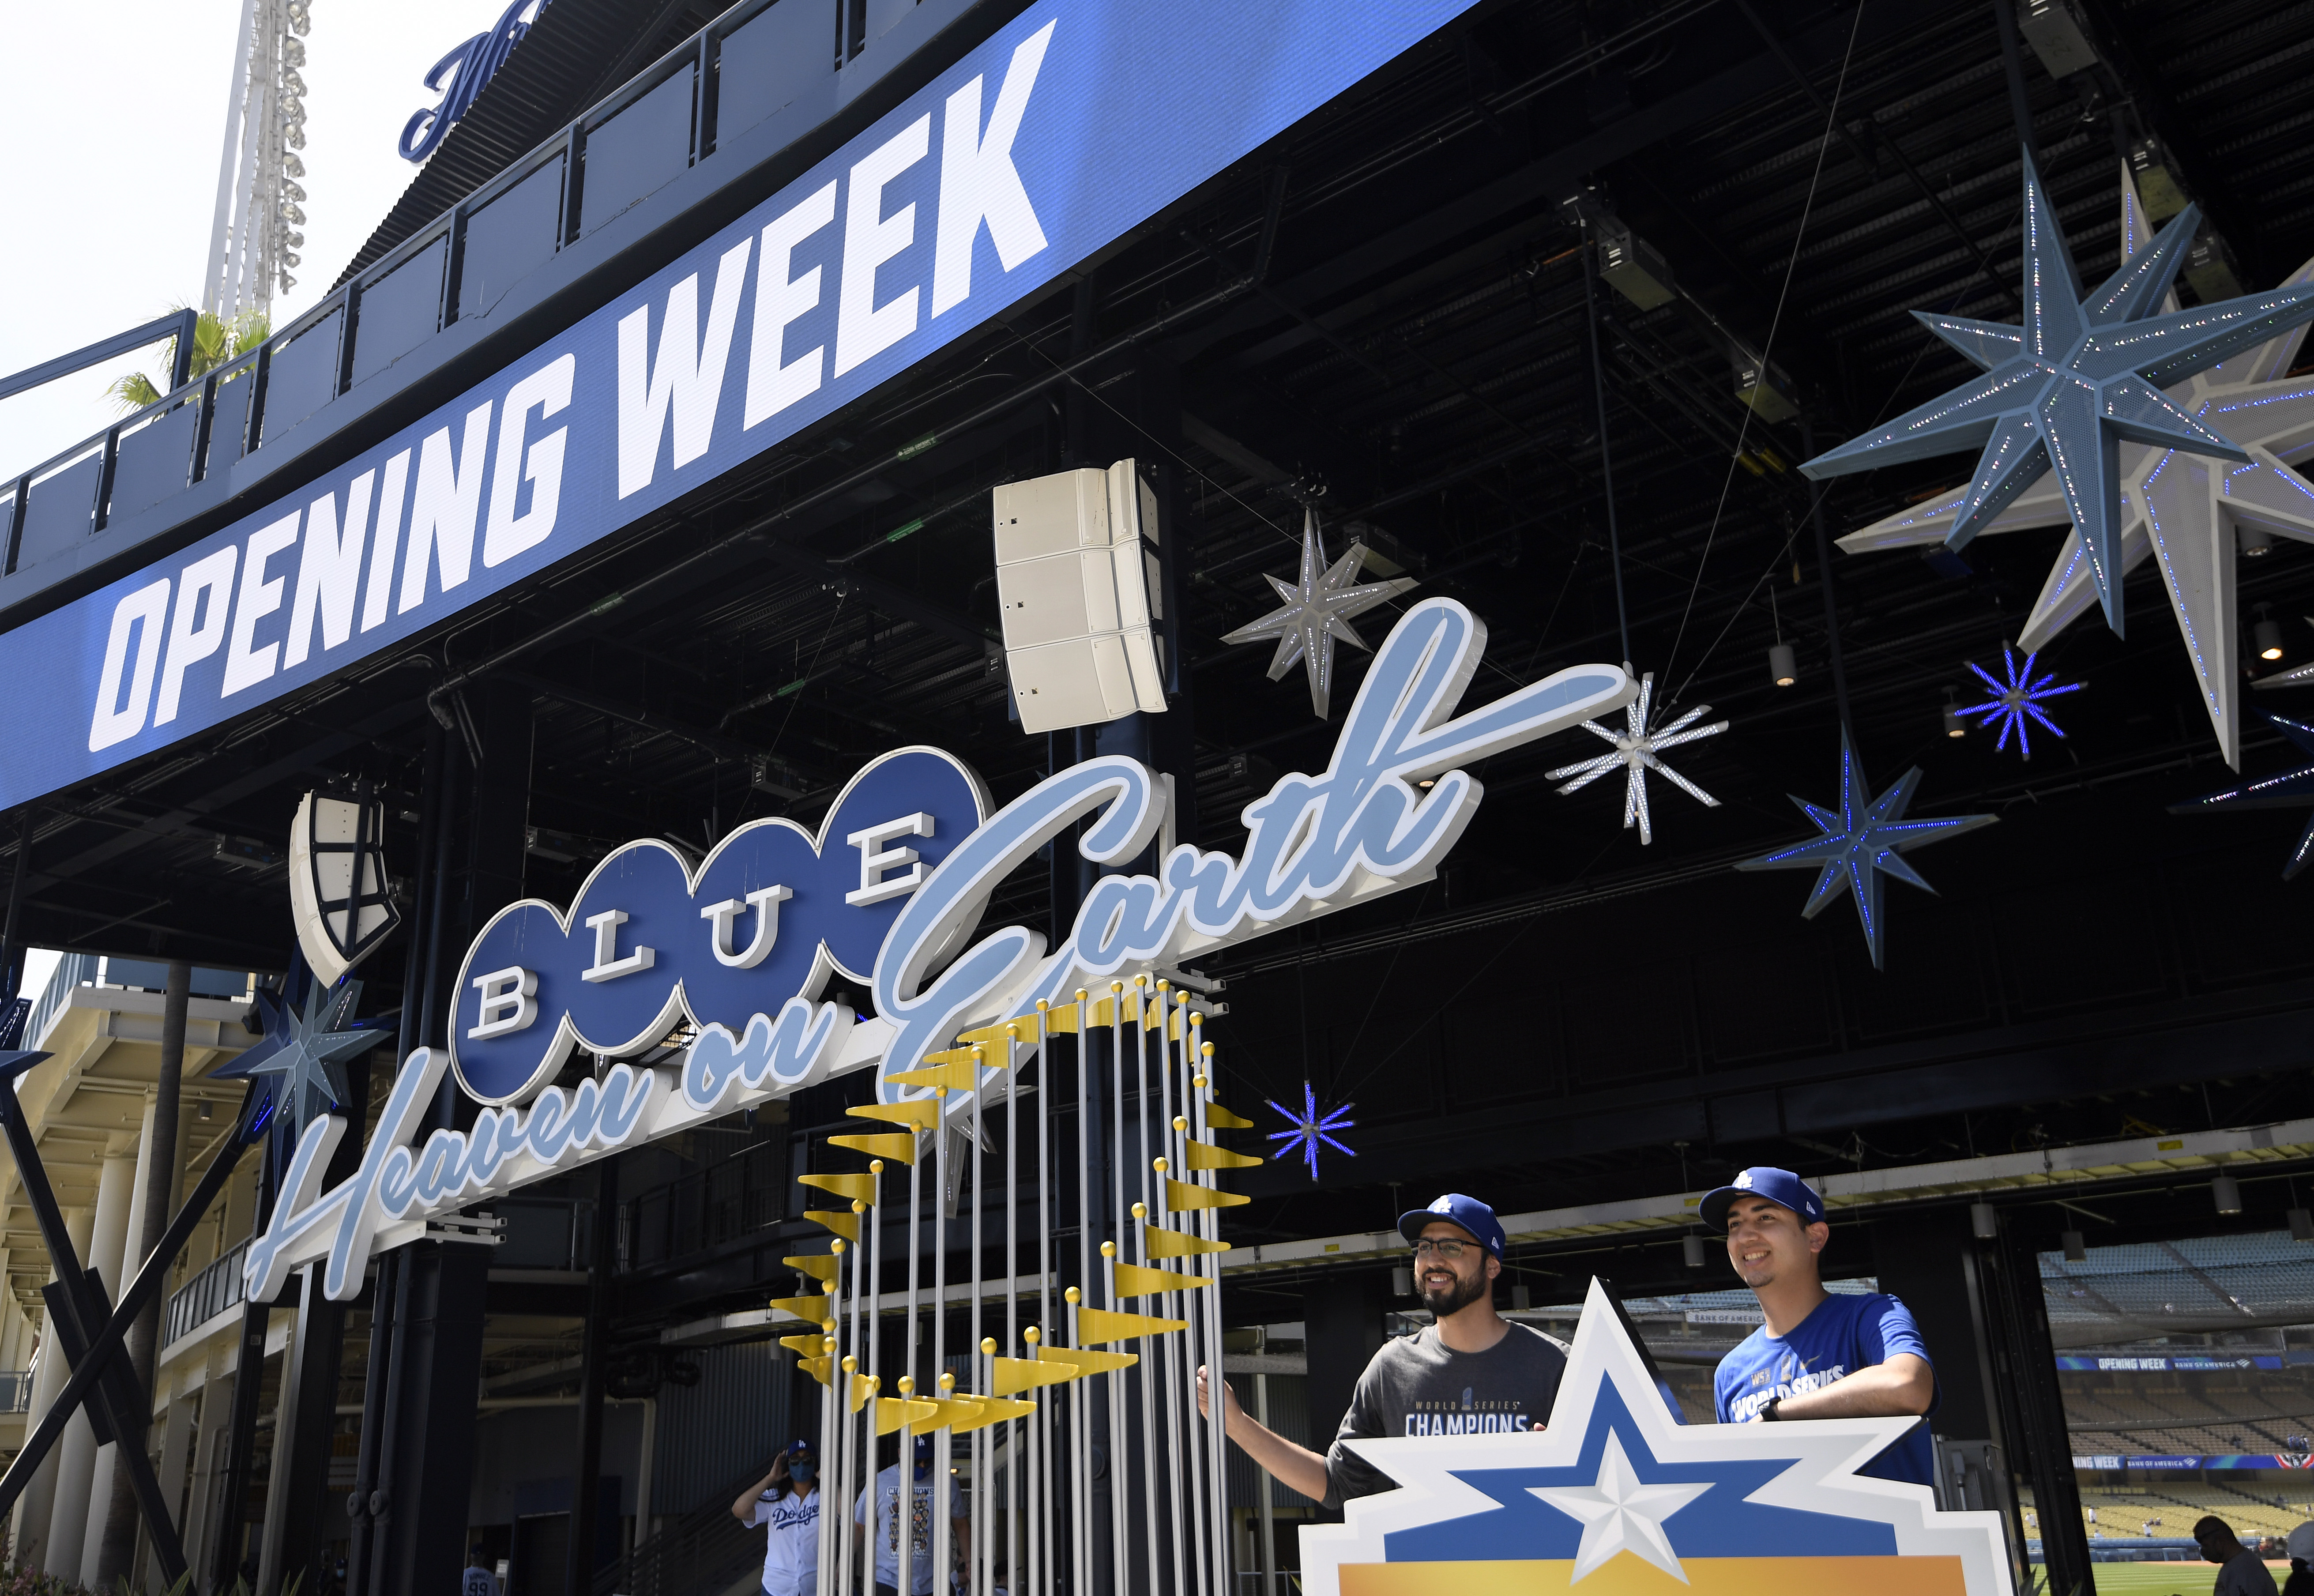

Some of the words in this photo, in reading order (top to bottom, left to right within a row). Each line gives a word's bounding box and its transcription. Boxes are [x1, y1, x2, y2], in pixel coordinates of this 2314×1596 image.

[89, 354, 575, 752] OPENING
[618, 18, 1057, 500] WEEK
[244, 1046, 662, 1302] Heaven
[681, 997, 845, 1112] on
[871, 597, 1637, 1109] Earth
[2099, 1358, 2137, 1370] OPENING
[2139, 1358, 2166, 1370] WEEK
[1416, 1401, 1456, 1410] WORLD
[1474, 1401, 1517, 1410] SERIES
[1406, 1413, 1528, 1437] CHAMPIONS
[798, 1439, 806, 1448] LA
[2072, 1456, 2092, 1468] NING
[2093, 1456, 2119, 1469] WEEK
[469, 1582, 487, 1596] 99
